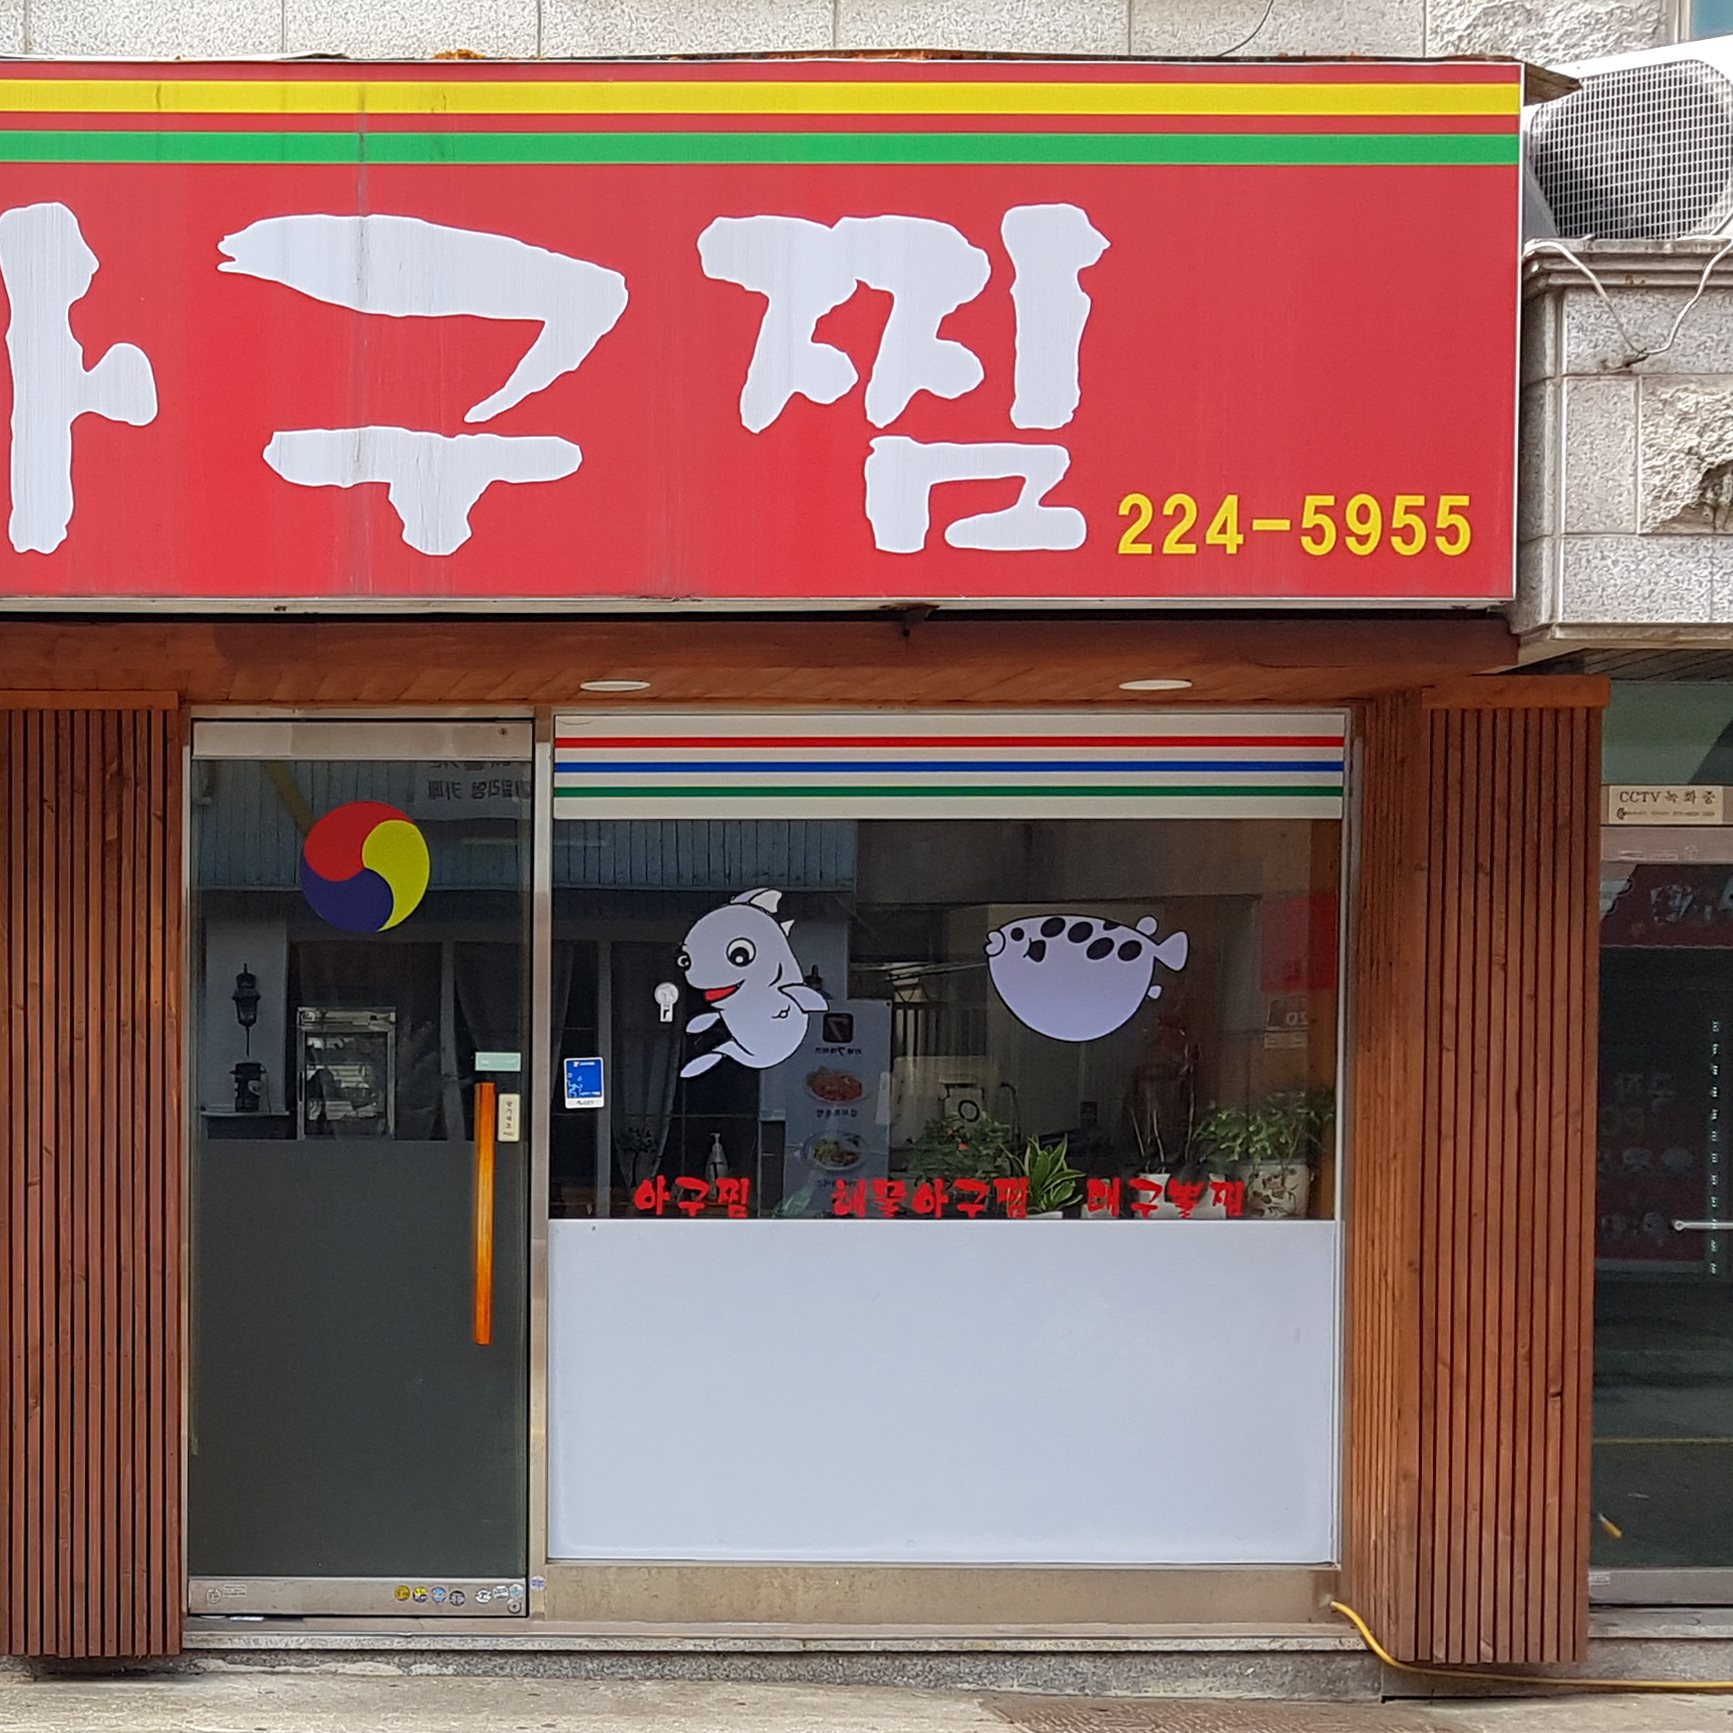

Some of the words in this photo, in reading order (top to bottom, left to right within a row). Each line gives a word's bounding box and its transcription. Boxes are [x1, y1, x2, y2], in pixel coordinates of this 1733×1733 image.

[1117, 493, 1472, 556] 224-5955
[1619, 791, 1661, 803] CCTV
[634, 1175, 750, 1218] 아구찜
[830, 1177, 1029, 1218] 해물아구찜
[1087, 1177, 1245, 1219] 대구뽈찜
